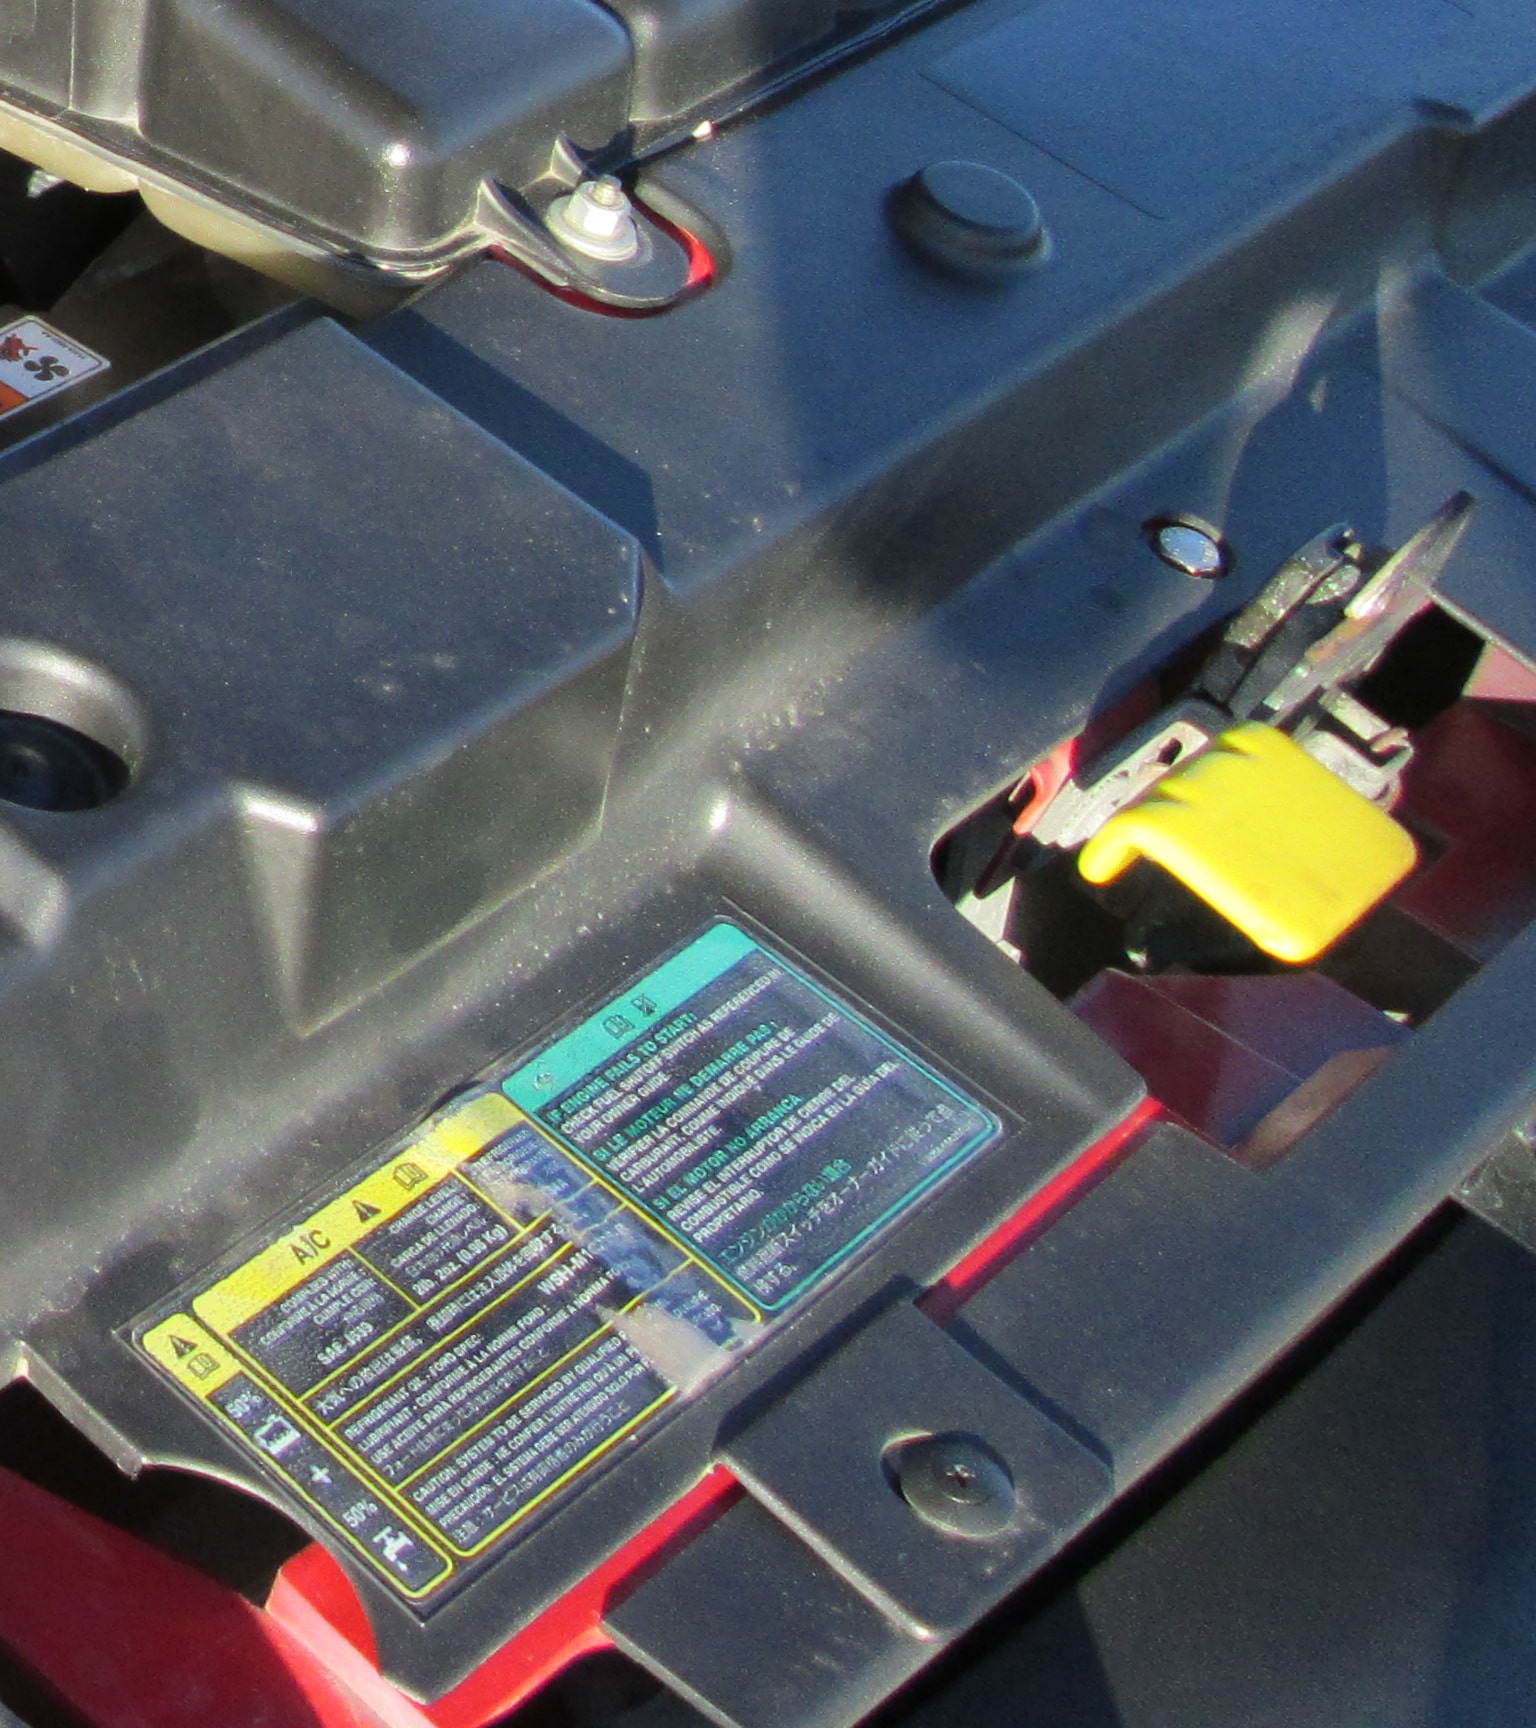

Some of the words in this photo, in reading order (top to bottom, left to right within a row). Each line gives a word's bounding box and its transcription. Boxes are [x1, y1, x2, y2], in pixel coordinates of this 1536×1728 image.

[558, 1103, 599, 1135] CHECK
[593, 1085, 624, 1109] FUEL
[618, 1054, 666, 1091] SHUTOFF
[659, 1028, 702, 1060] SWITCH
[694, 1018, 715, 1033] AS
[559, 1075, 609, 1114] ENGINE
[603, 1051, 642, 1081] FAILS
[636, 1038, 660, 1057] TO
[591, 1145, 612, 1162] SI
[605, 1132, 629, 1152] LE
[623, 1095, 677, 1138] MOTEUR
[744, 1023, 773, 1045] PAS
[649, 1122, 670, 1139] LA
[663, 1082, 724, 1129] COMMANDE
[717, 1070, 739, 1087] DE
[732, 1036, 783, 1076] COUPURE
[775, 1026, 797, 1042] DE
[752, 1053, 786, 1079] DANS
[778, 1043, 799, 1059] LE
[791, 1022, 827, 1049] GUIDE
[572, 1118, 607, 1145] YOUR
[599, 1092, 642, 1125] OWNER
[664, 1186, 708, 1222] REVISE
[700, 1176, 722, 1194] EL
[715, 1124, 788, 1184] INTERRUPTOR
[780, 1113, 803, 1131] DE
[794, 1085, 838, 1120] CIERRE
[829, 1071, 857, 1092] DEL
[677, 1171, 754, 1234] COMBUSTIBLE
[746, 1148, 784, 1179] COMO
[776, 1137, 798, 1155] SE
[791, 1112, 830, 1144] INDICA
[822, 1101, 844, 1118] EN
[836, 1090, 858, 1107] LA
[651, 1194, 672, 1211] SI
[665, 1181, 688, 1200] EL
[682, 1148, 730, 1187] MOTOR
[724, 1133, 749, 1153] NO
[282, 1225, 335, 1266] A/C
[314, 1339, 348, 1366] SAE
[354, 1405, 416, 1452] LUBRIFIANT
[413, 1363, 471, 1407] CONFORME
[471, 1348, 490, 1363] LA
[483, 1323, 522, 1353] NORME
[515, 1305, 546, 1329] FORD
[368, 1443, 395, 1465] USE
[388, 1418, 429, 1450] ACEITE
[421, 1399, 453, 1424] PARA
[444, 1344, 524, 1405] REFRIGERANTES
[516, 1308, 571, 1351] CONFORME
[569, 1275, 613, 1308] NORMA
[223, 1388, 265, 1419] 50%
[453, 1434, 498, 1470] SYSTEM
[491, 1424, 510, 1440] TO
[503, 1413, 523, 1430] BE
[516, 1379, 567, 1419] SERVICED
[559, 1369, 579, 1386] BY
[571, 1334, 624, 1376] QUALIFIED
[489, 1470, 508, 1486] EL
[500, 1445, 540, 1478] SISTEMA
[602, 1374, 630, 1396] SOLO
[339, 1496, 379, 1528] 50%
[422, 1491, 453, 1516] MISE
[445, 1481, 465, 1498] EN
[457, 1458, 496, 1488] GARDE
